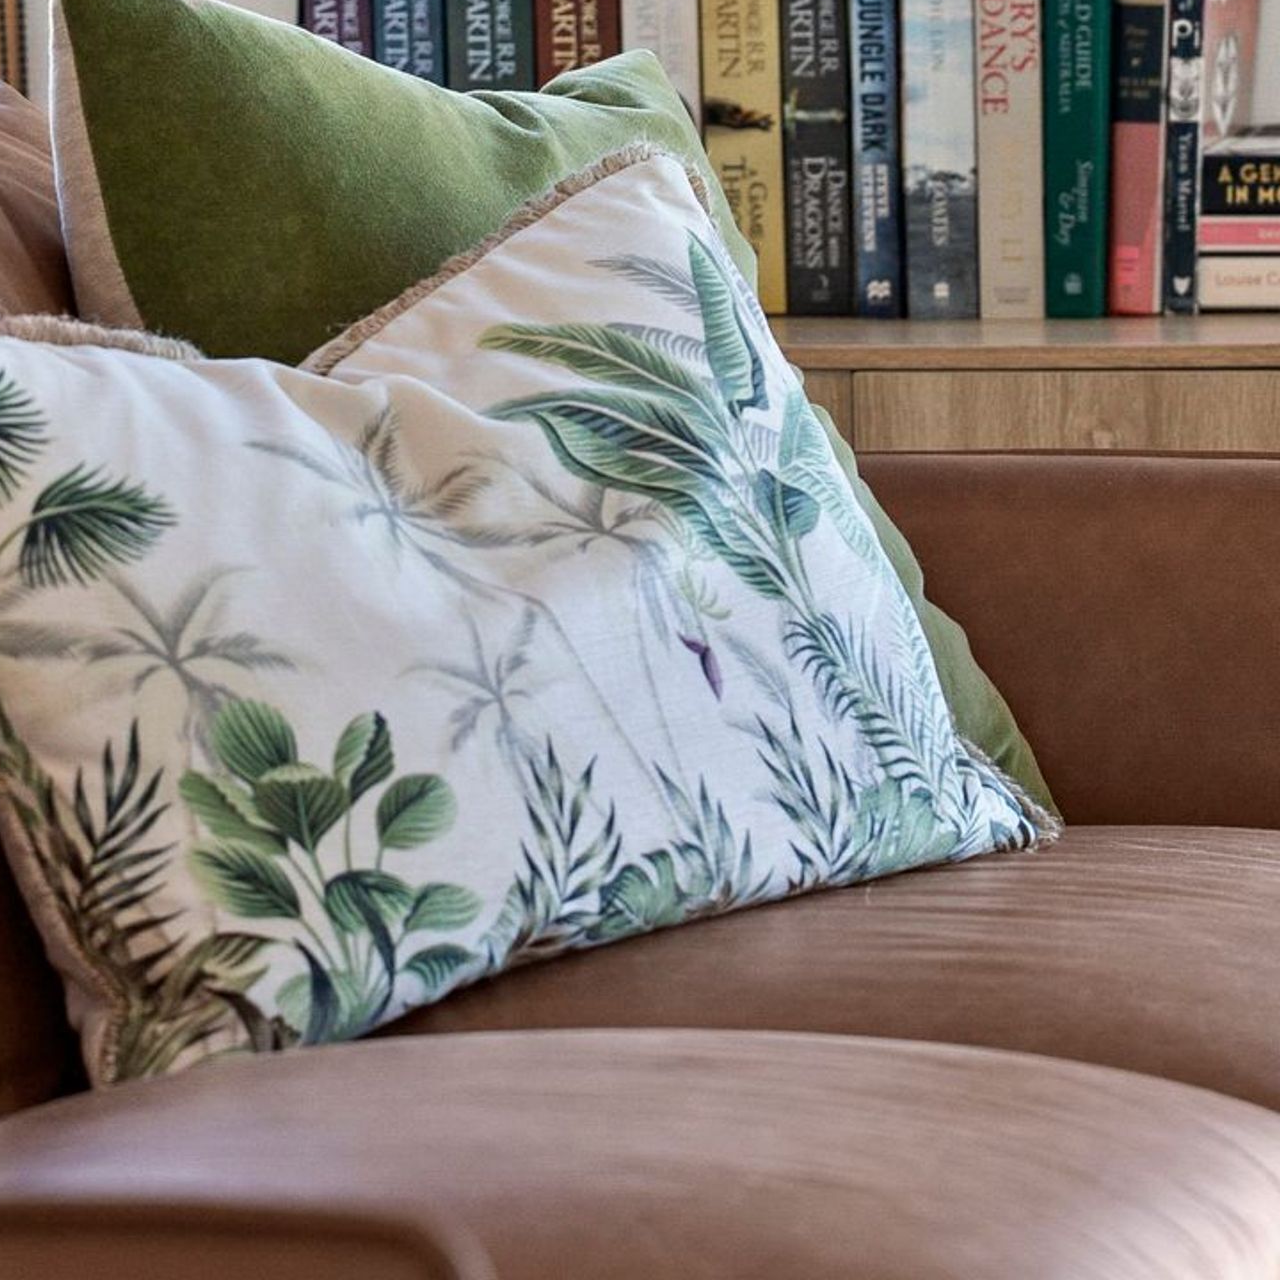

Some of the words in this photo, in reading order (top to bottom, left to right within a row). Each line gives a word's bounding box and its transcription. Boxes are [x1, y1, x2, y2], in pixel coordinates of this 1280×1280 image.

[1075, 25, 1092, 90] GUIDE
[1172, 19, 1200, 48] Pi
[861, 93, 887, 152] DARK
[1178, 132, 1193, 173] Yann
[1218, 164, 1232, 183] A
[749, 182, 768, 237] GAME
[802, 157, 827, 269] DRAGONS
[827, 170, 846, 233] DANCE
[876, 164, 889, 218] STEVE
[1177, 179, 1193, 231] Martel
[1226, 185, 1249, 204] IN
